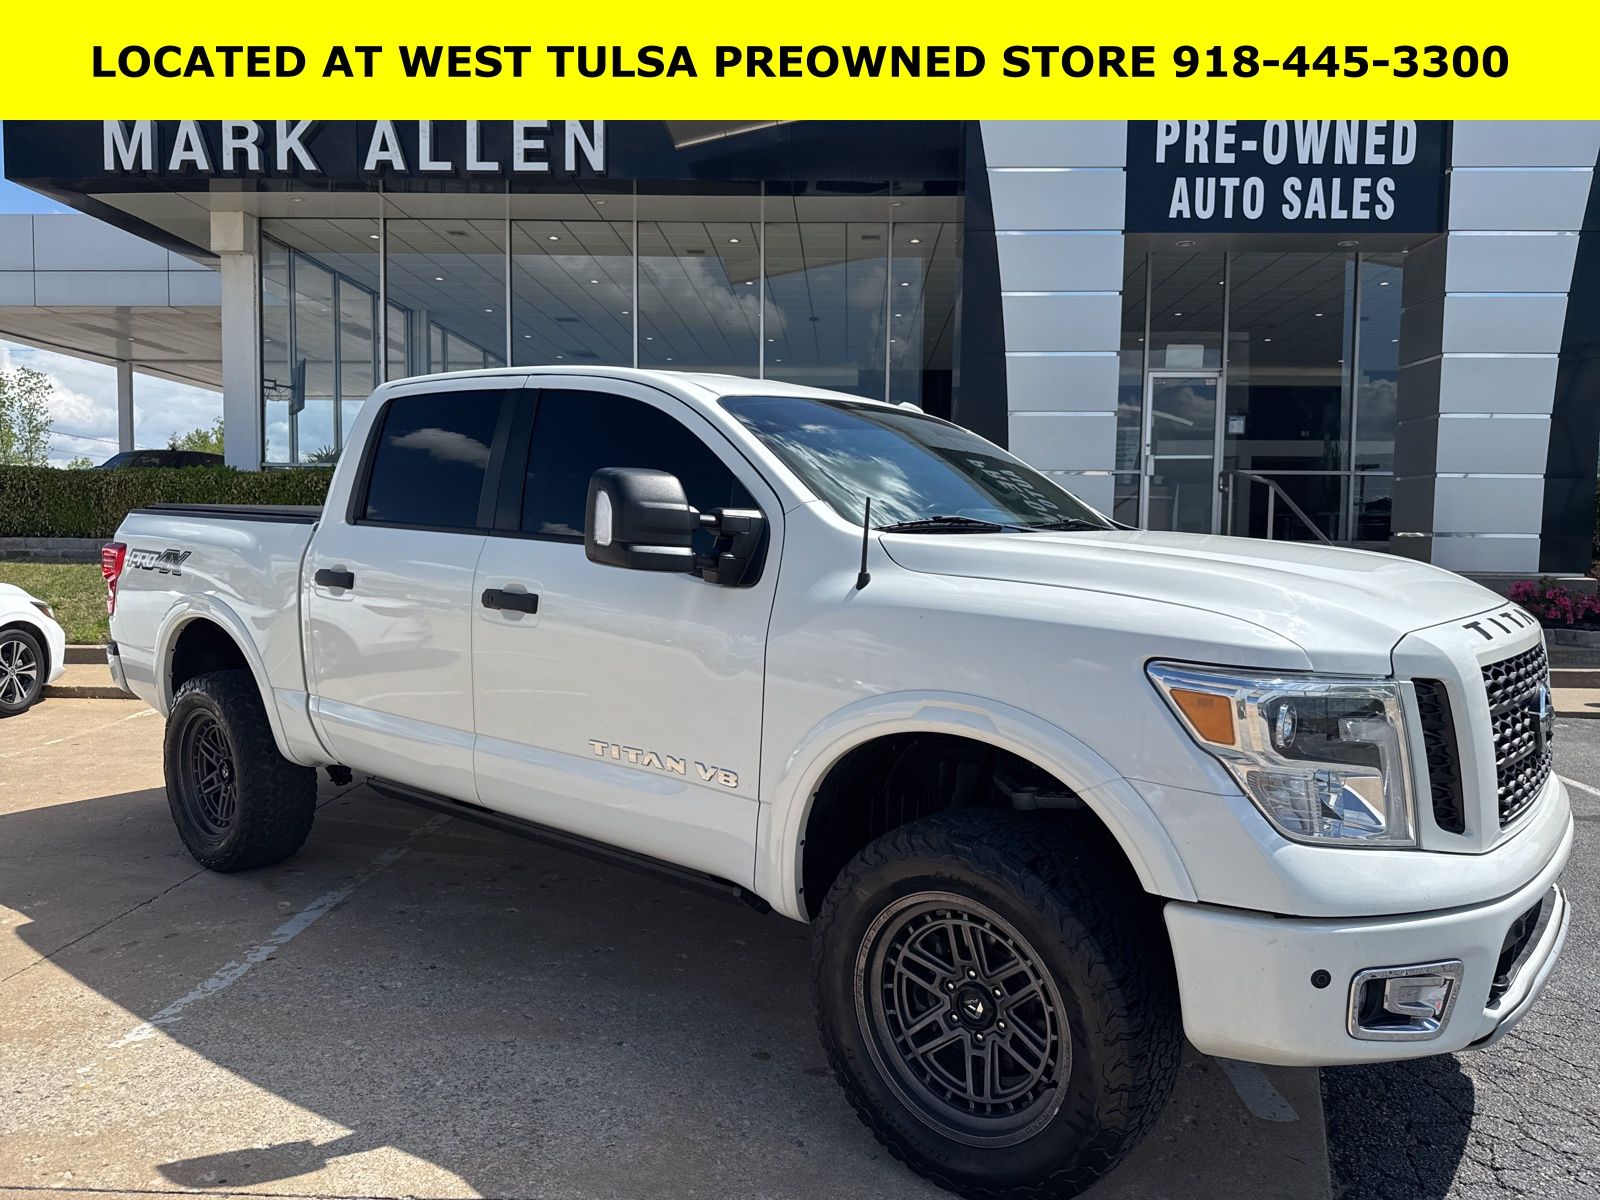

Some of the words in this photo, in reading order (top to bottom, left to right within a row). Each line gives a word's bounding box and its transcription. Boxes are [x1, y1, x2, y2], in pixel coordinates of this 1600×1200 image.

[103, 121, 317, 171] MARK
[363, 121, 606, 171] ALLEN
[1155, 121, 1417, 165] PRE-OWNED
[1168, 176, 1265, 220] AUTO
[1281, 176, 1396, 221] SALES
[589, 739, 687, 776] TITAN
[694, 761, 739, 788] V8
